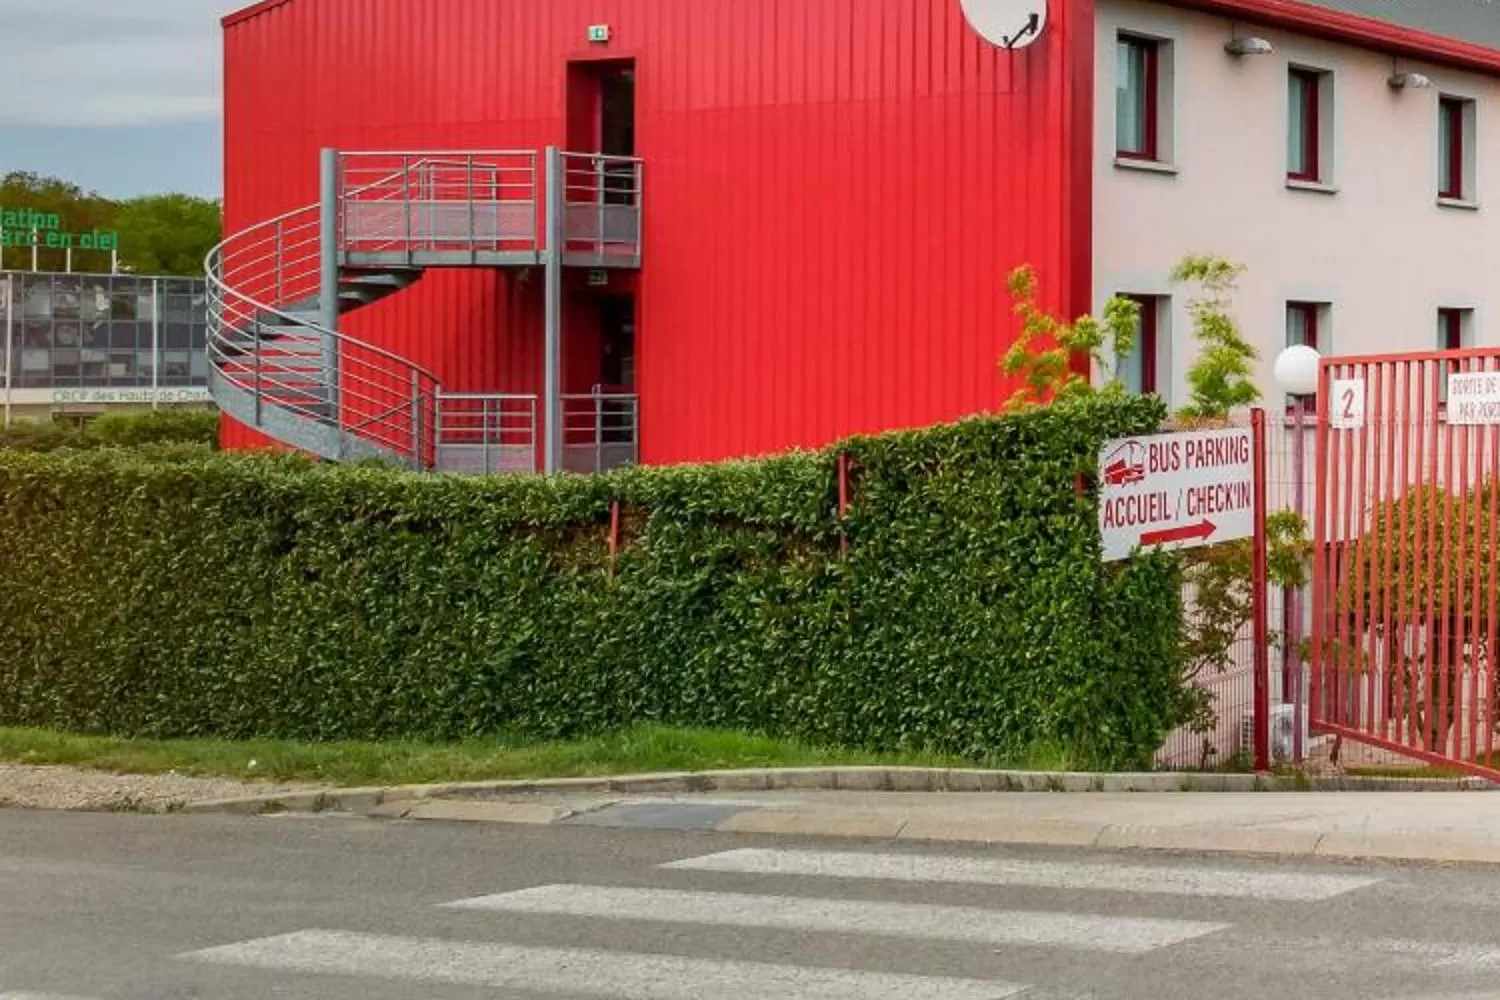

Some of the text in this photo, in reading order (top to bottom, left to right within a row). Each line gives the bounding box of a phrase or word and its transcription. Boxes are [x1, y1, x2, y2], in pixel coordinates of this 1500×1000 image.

[0, 206, 59, 229] ation
[1485, 377, 1499, 394] DE
[1341, 388, 1355, 419] 2
[1149, 435, 1249, 473] BUS PARKING
[1104, 491, 1172, 529] ACCUEIL
[1187, 482, 1251, 517] CHECK'IN
